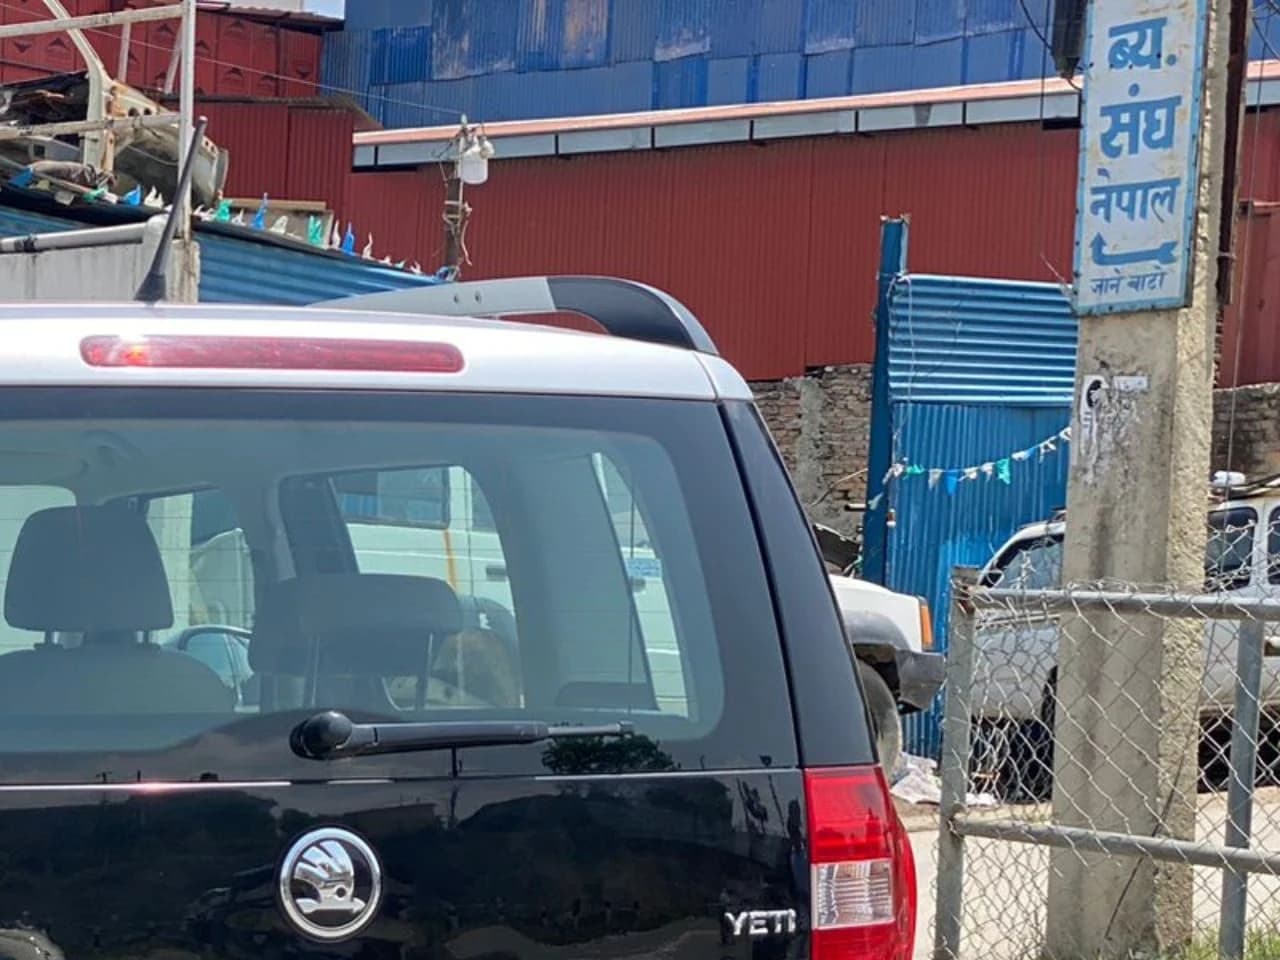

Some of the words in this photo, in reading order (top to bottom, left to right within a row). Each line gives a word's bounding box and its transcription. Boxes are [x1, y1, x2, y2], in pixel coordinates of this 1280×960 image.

[1100, 83, 1182, 159] संघ
[1089, 168, 1181, 223] नेपाल
[724, 908, 796, 936] YETI
